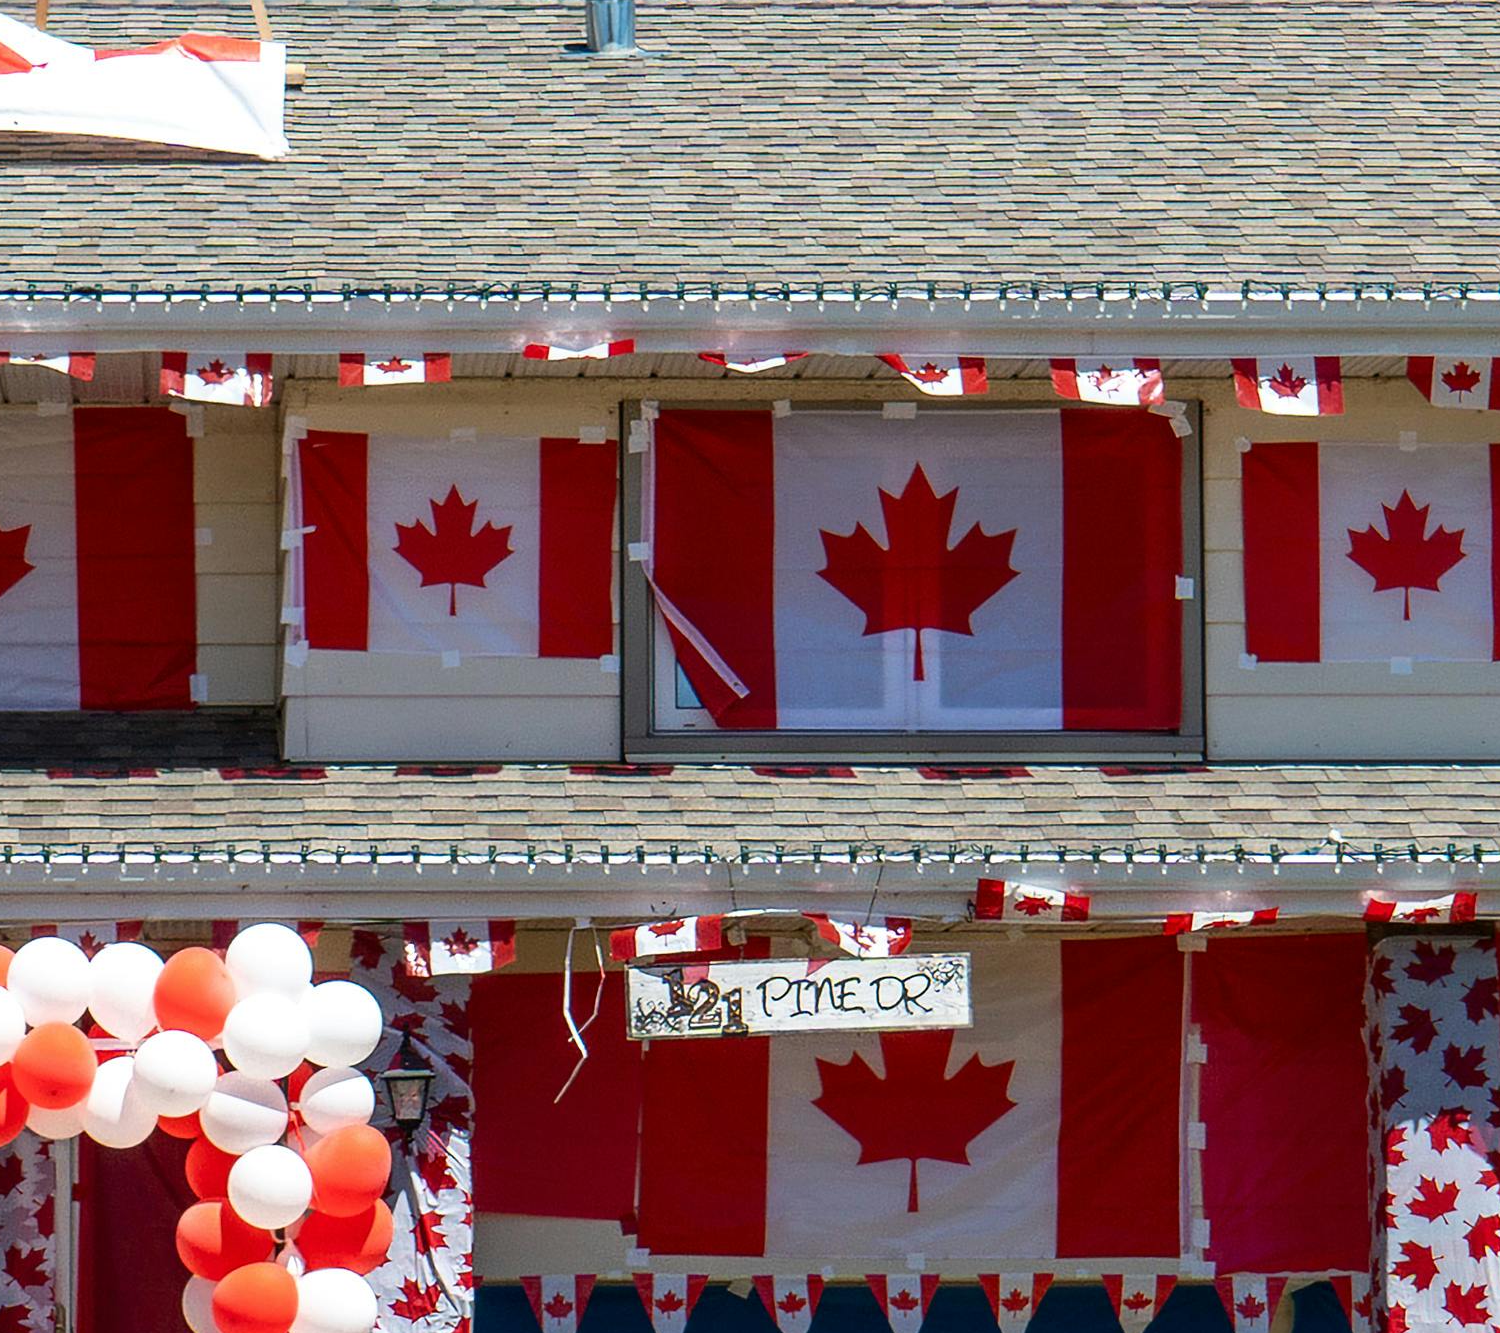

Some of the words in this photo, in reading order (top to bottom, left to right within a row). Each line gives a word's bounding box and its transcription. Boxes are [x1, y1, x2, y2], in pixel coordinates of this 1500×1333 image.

[662, 968, 749, 1035] 121
[756, 975, 865, 1018] PINE
[869, 973, 934, 1015] DR
